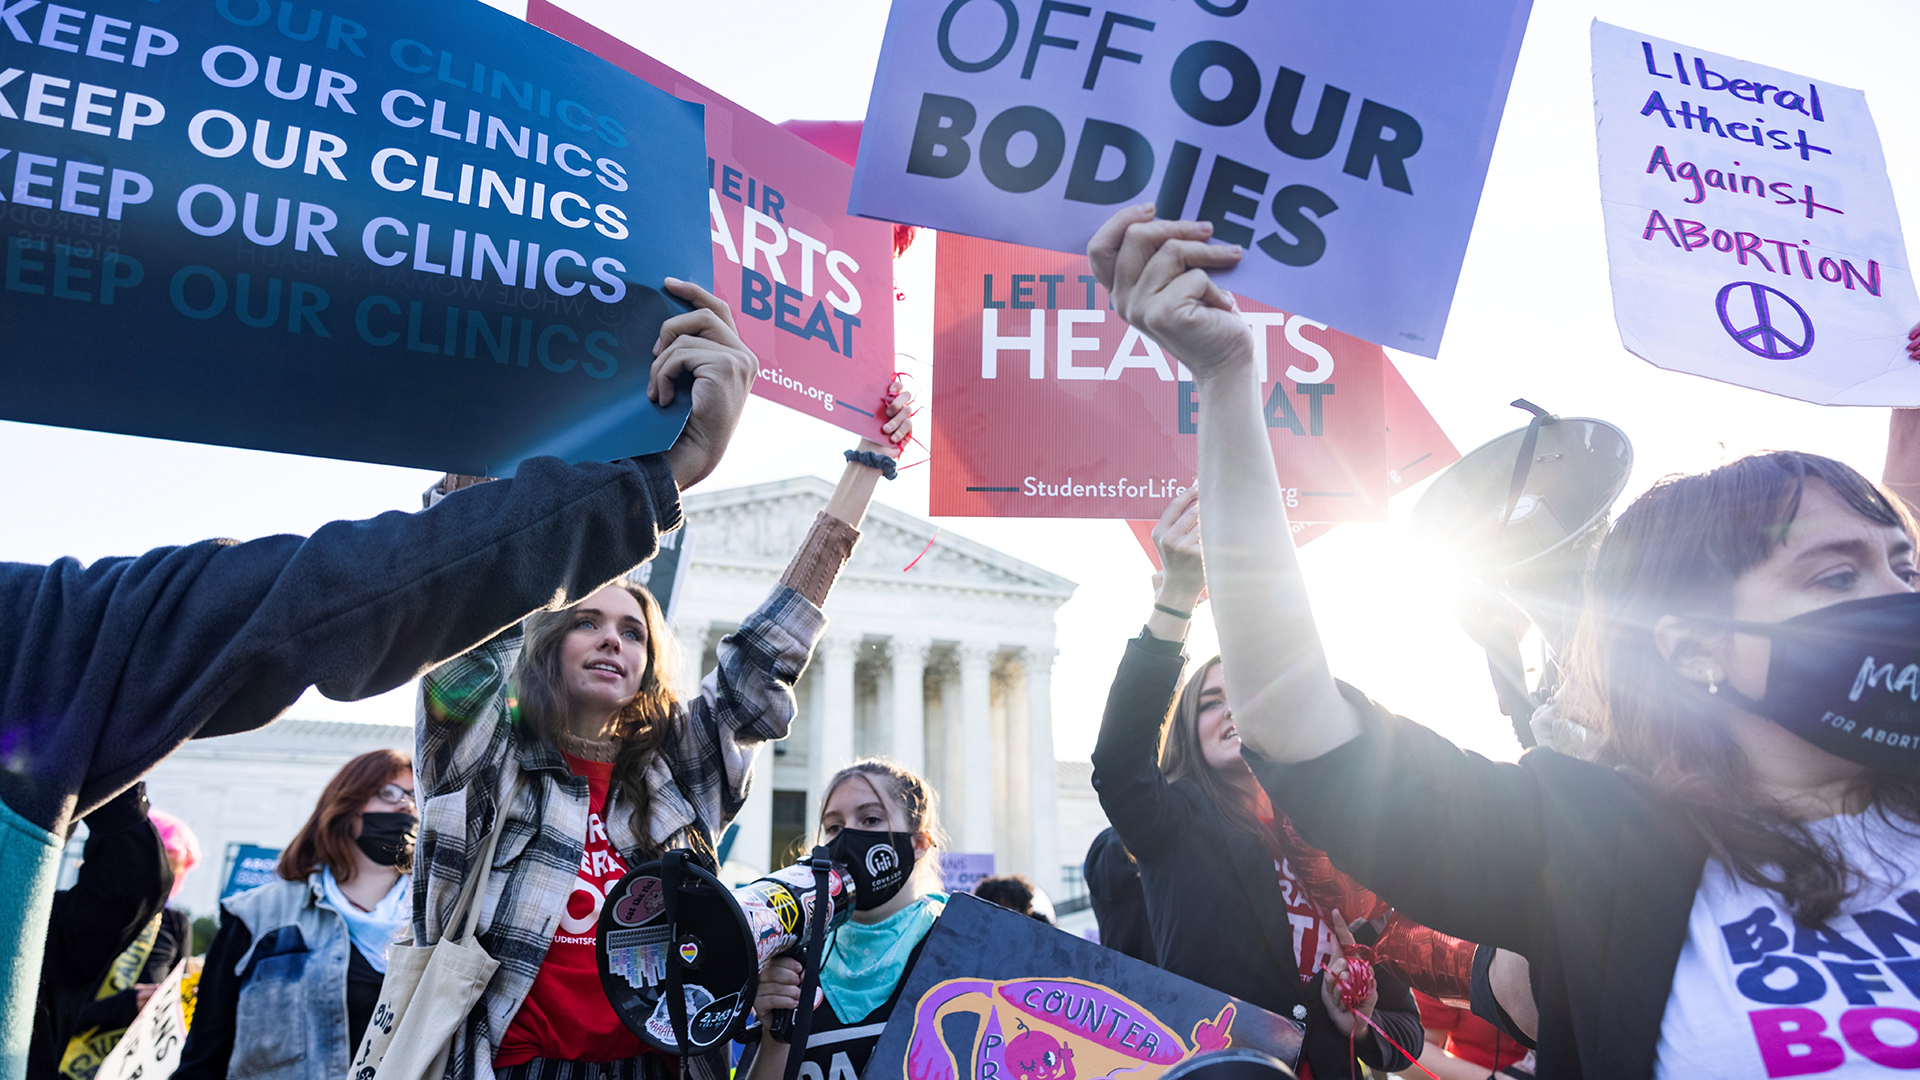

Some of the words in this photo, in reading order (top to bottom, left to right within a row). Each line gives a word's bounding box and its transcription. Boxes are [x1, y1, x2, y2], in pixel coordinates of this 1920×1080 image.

[0, 0, 179, 68] KEEP
[201, 45, 358, 115] OUR
[380, 89, 629, 192] CLINICS
[389, 38, 627, 148] CLINICS
[937, 0, 1156, 91] OFF
[1170, 40, 1424, 196] OUR
[1640, 90, 1831, 161] Atheist
[188, 109, 348, 181] OUR
[371, 148, 629, 240] CLINICS
[906, 92, 1339, 267] BODIES
[1646, 145, 1844, 219] Against
[0, 148, 154, 221] EEP
[177, 183, 338, 257] OUR
[362, 216, 627, 304] CLINICS
[169, 265, 331, 338] OUR
[355, 295, 619, 379] CLINICS
[741, 266, 862, 359] BEAT
[984, 274, 1065, 310] LET
[757, 364, 834, 412] ction.org
[981, 309, 1335, 384] HEATS
[1821, 711, 1857, 733] FOR
[625, 907, 636, 921] eat
[632, 893, 645, 906] the
[1024, 987, 1161, 1058] COUNTER
